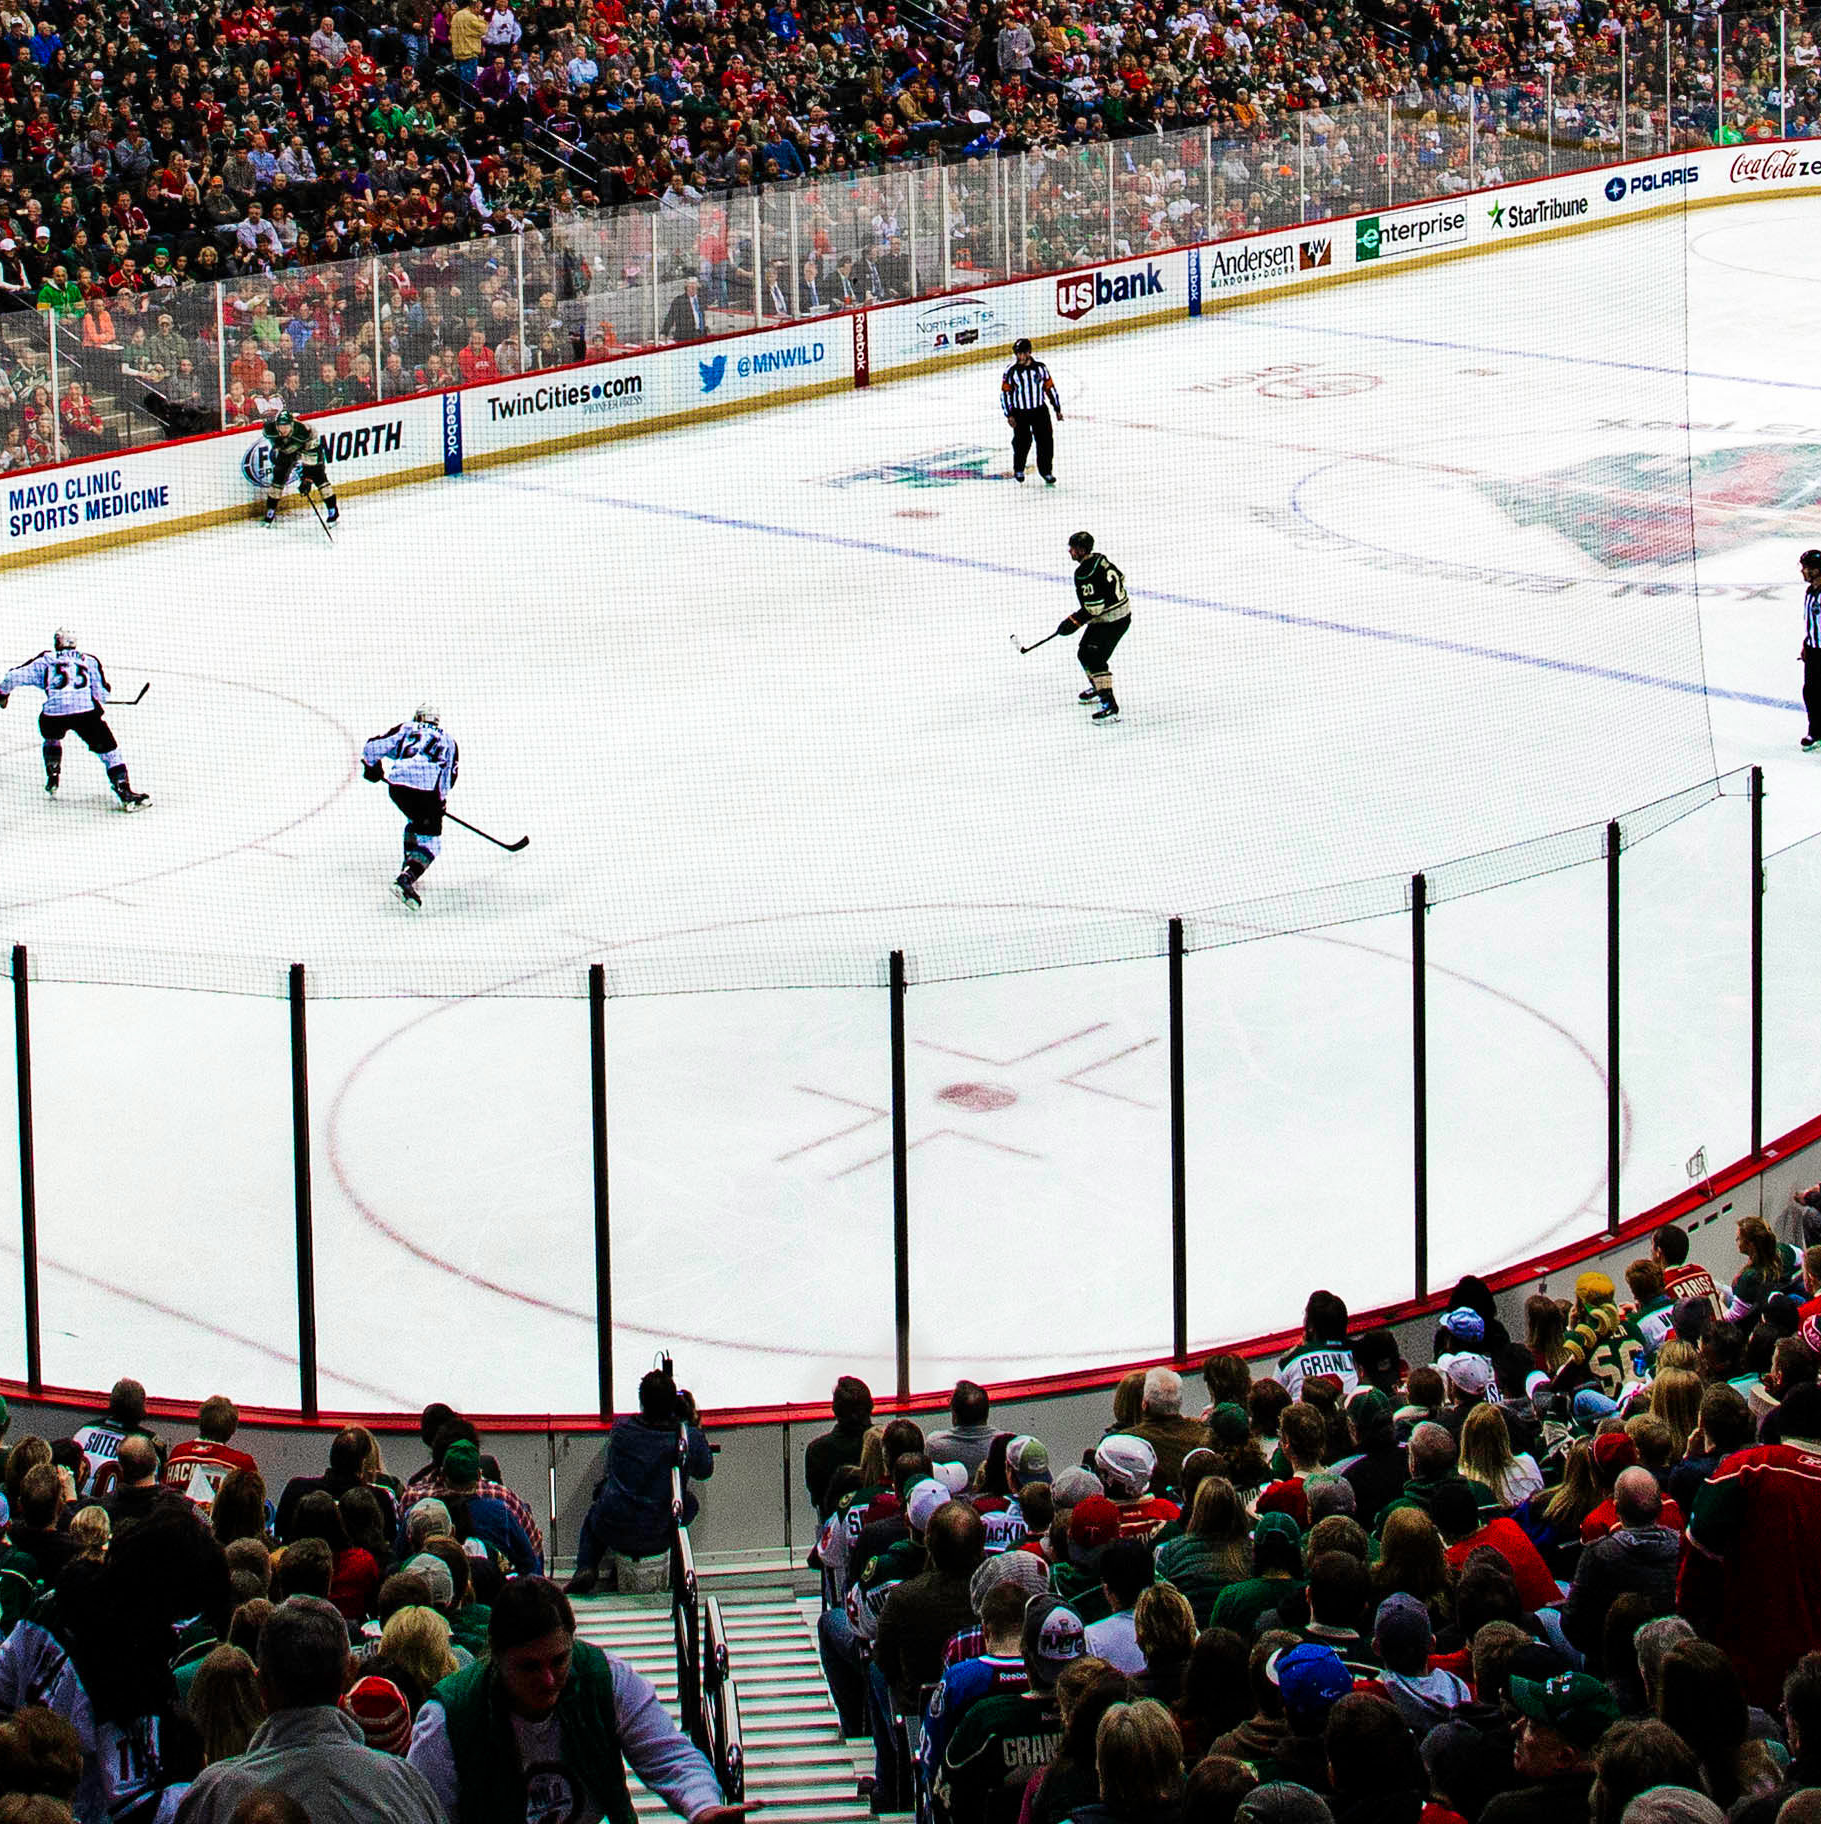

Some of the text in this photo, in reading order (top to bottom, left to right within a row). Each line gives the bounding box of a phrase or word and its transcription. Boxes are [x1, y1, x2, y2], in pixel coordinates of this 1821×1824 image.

[1630, 166, 1700, 194] POLARIS
[1730, 149, 1798, 183] Coca-Cola
[1362, 210, 1466, 249] enterprise
[1507, 195, 1588, 229] StarTribune
[1189, 248, 1200, 302] Reebok
[1211, 243, 1295, 278] Andersen
[737, 342, 824, 378] @MNWILD
[854, 314, 866, 371] Reebok
[318, 420, 402, 464] NORTH
[445, 393, 458, 455] Reebok
[9, 470, 122, 512] MAYO CLINIC
[9, 485, 170, 537] SPORTS MEDICINE
[50, 662, 89, 690] 55
